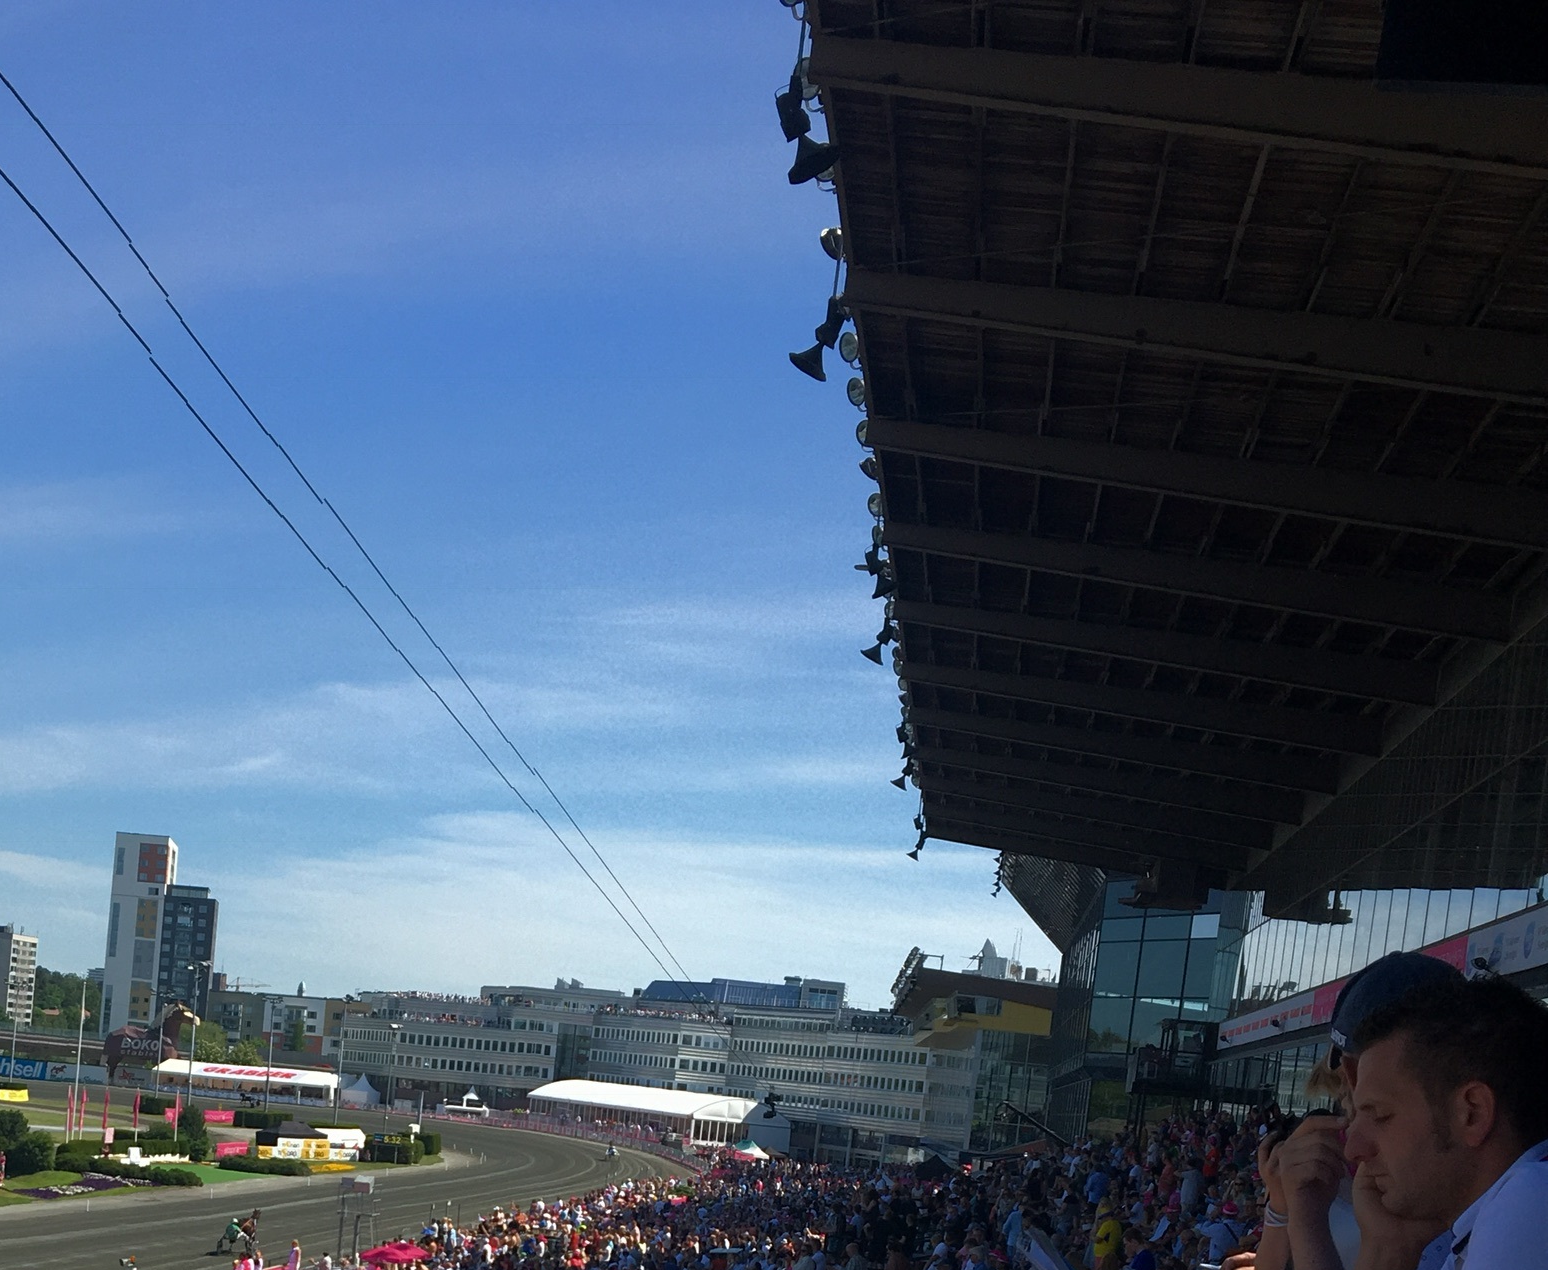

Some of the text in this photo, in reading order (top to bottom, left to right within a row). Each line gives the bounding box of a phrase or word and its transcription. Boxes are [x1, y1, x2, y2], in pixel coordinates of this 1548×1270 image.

[121, 1037, 158, 1050] BOKO
[203, 1066, 298, 1079] GRABBER
[383, 1136, 402, 1144] 5:32
